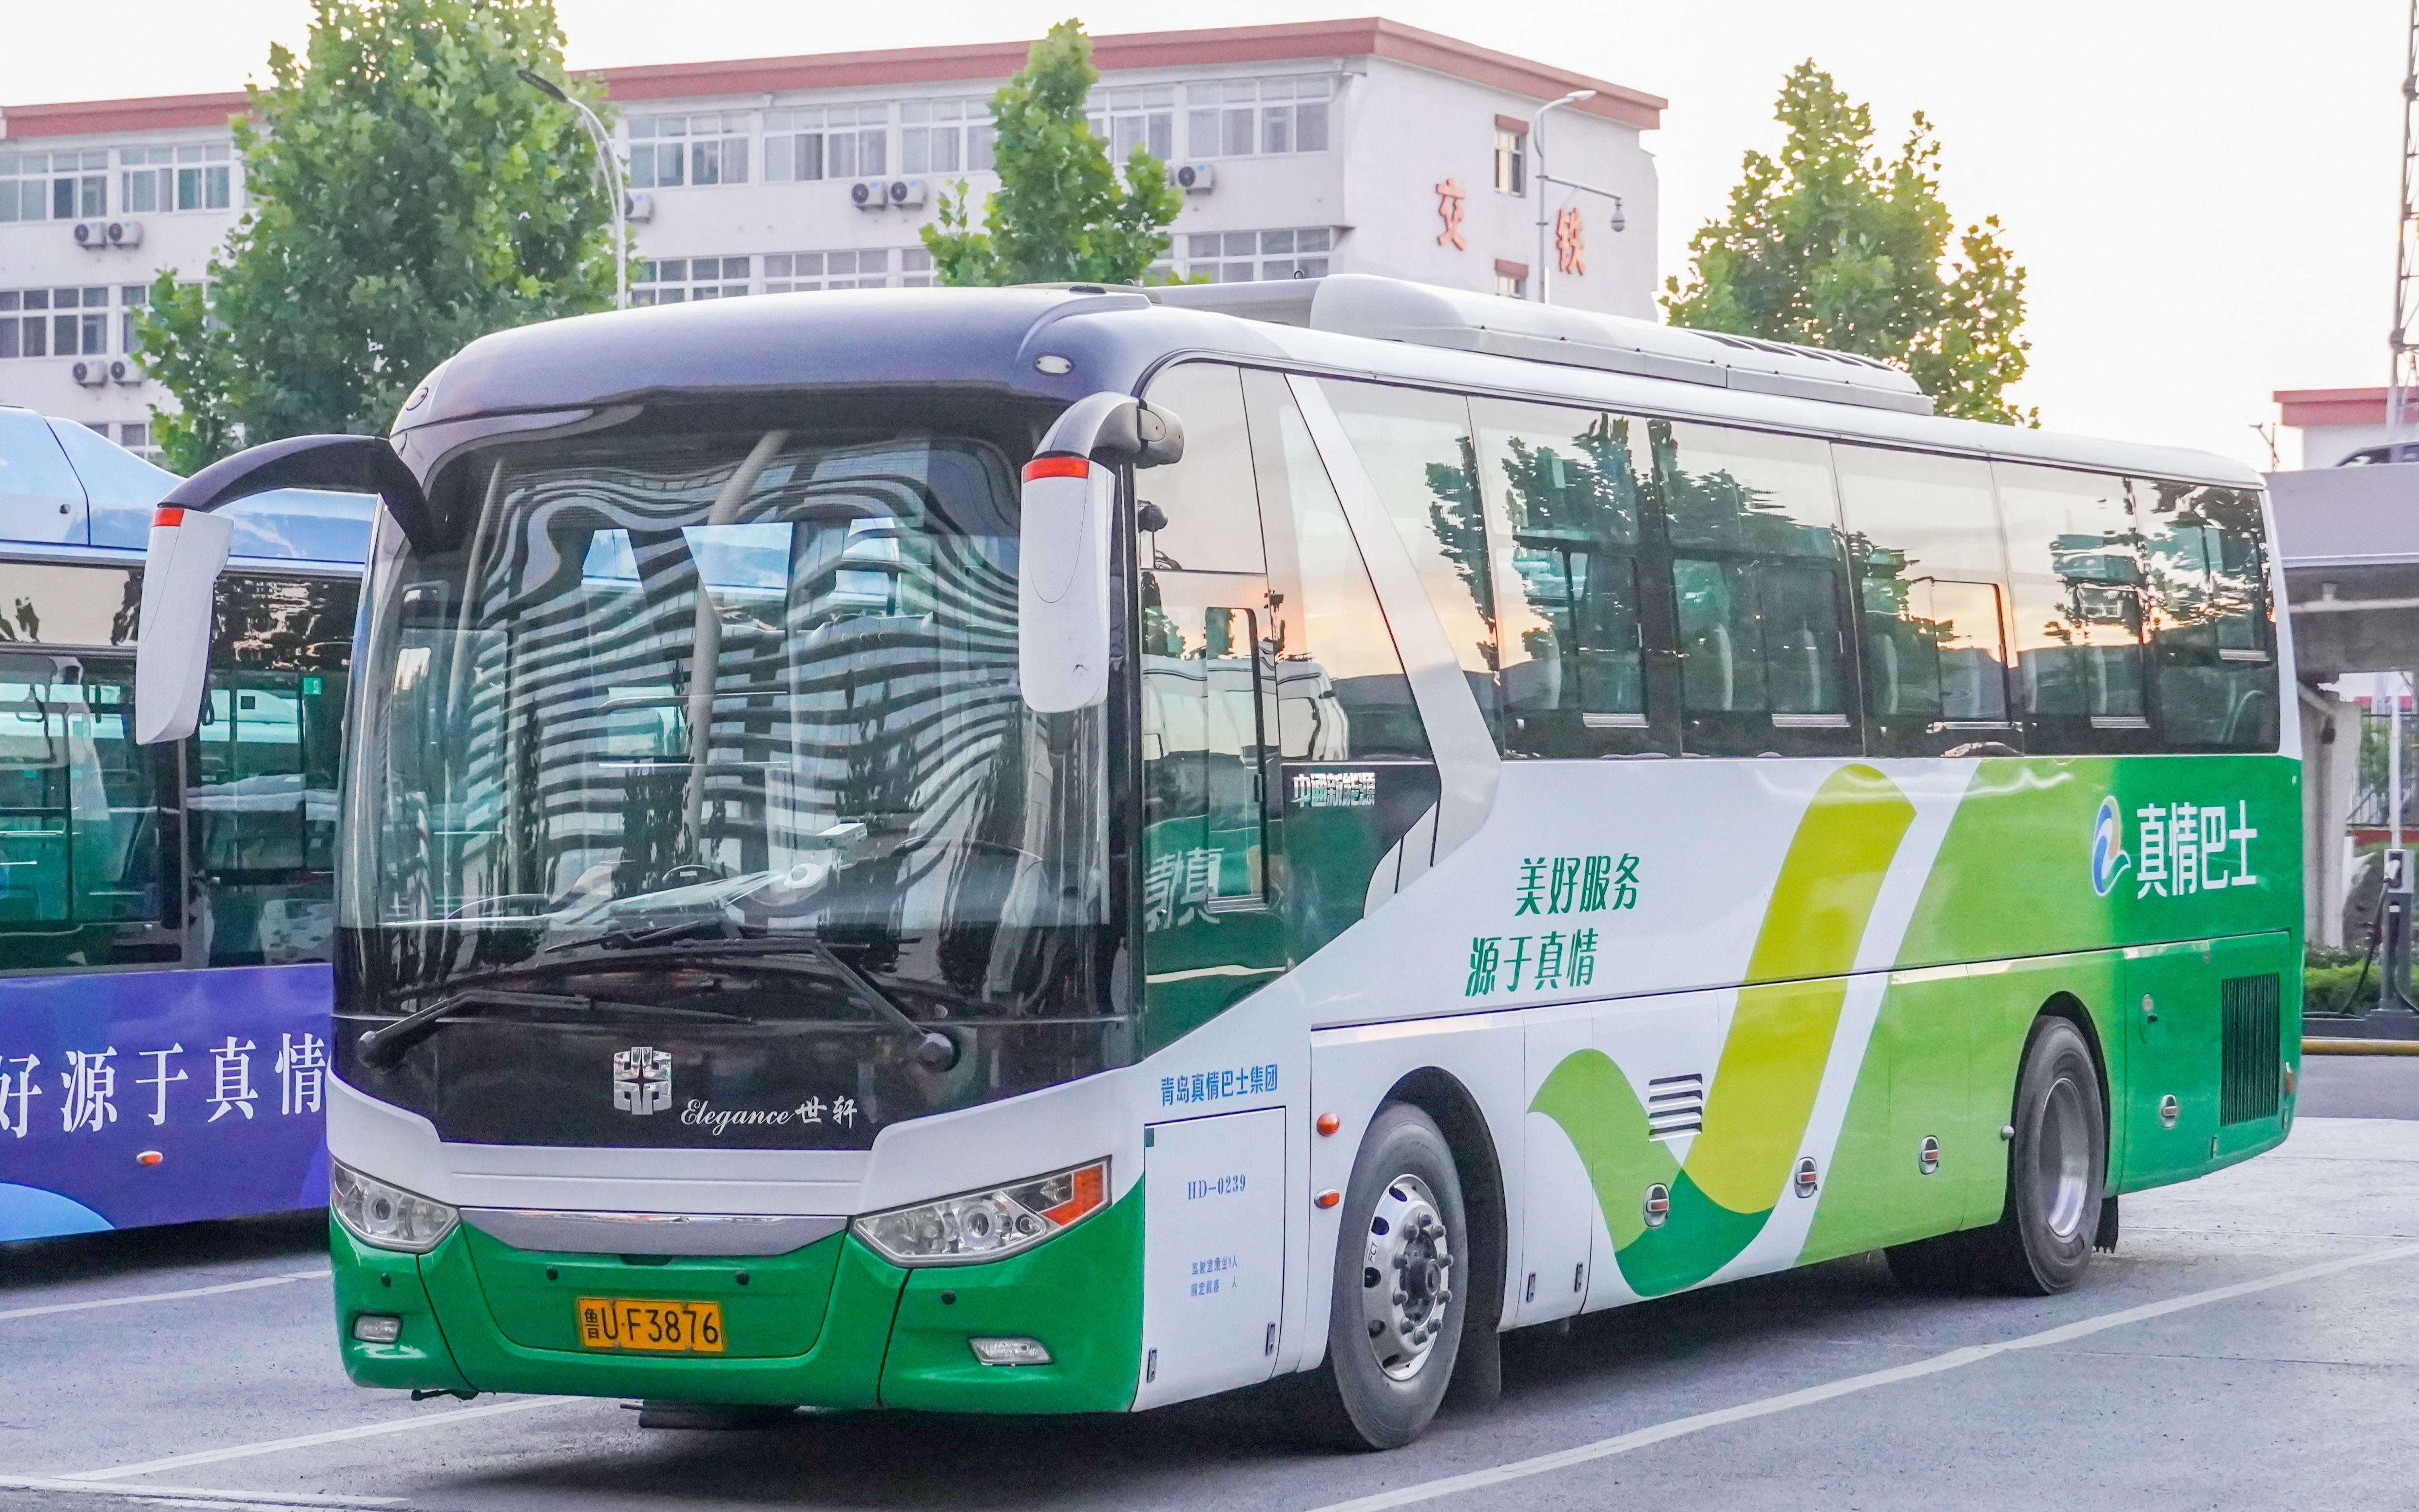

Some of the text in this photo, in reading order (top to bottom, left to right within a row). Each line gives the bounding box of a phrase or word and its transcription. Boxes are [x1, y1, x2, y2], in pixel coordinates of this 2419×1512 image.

[2137, 800, 2258, 899] 真情巴士
[1515, 853, 1640, 916] 美好服务
[1465, 928, 1598, 996] 源于真情
[1161, 1064, 1278, 1107] 青岛真情巴士集团
[681, 1095, 858, 1135] Elegance 世轩
[1188, 1173, 1246, 1200] HD-0239
